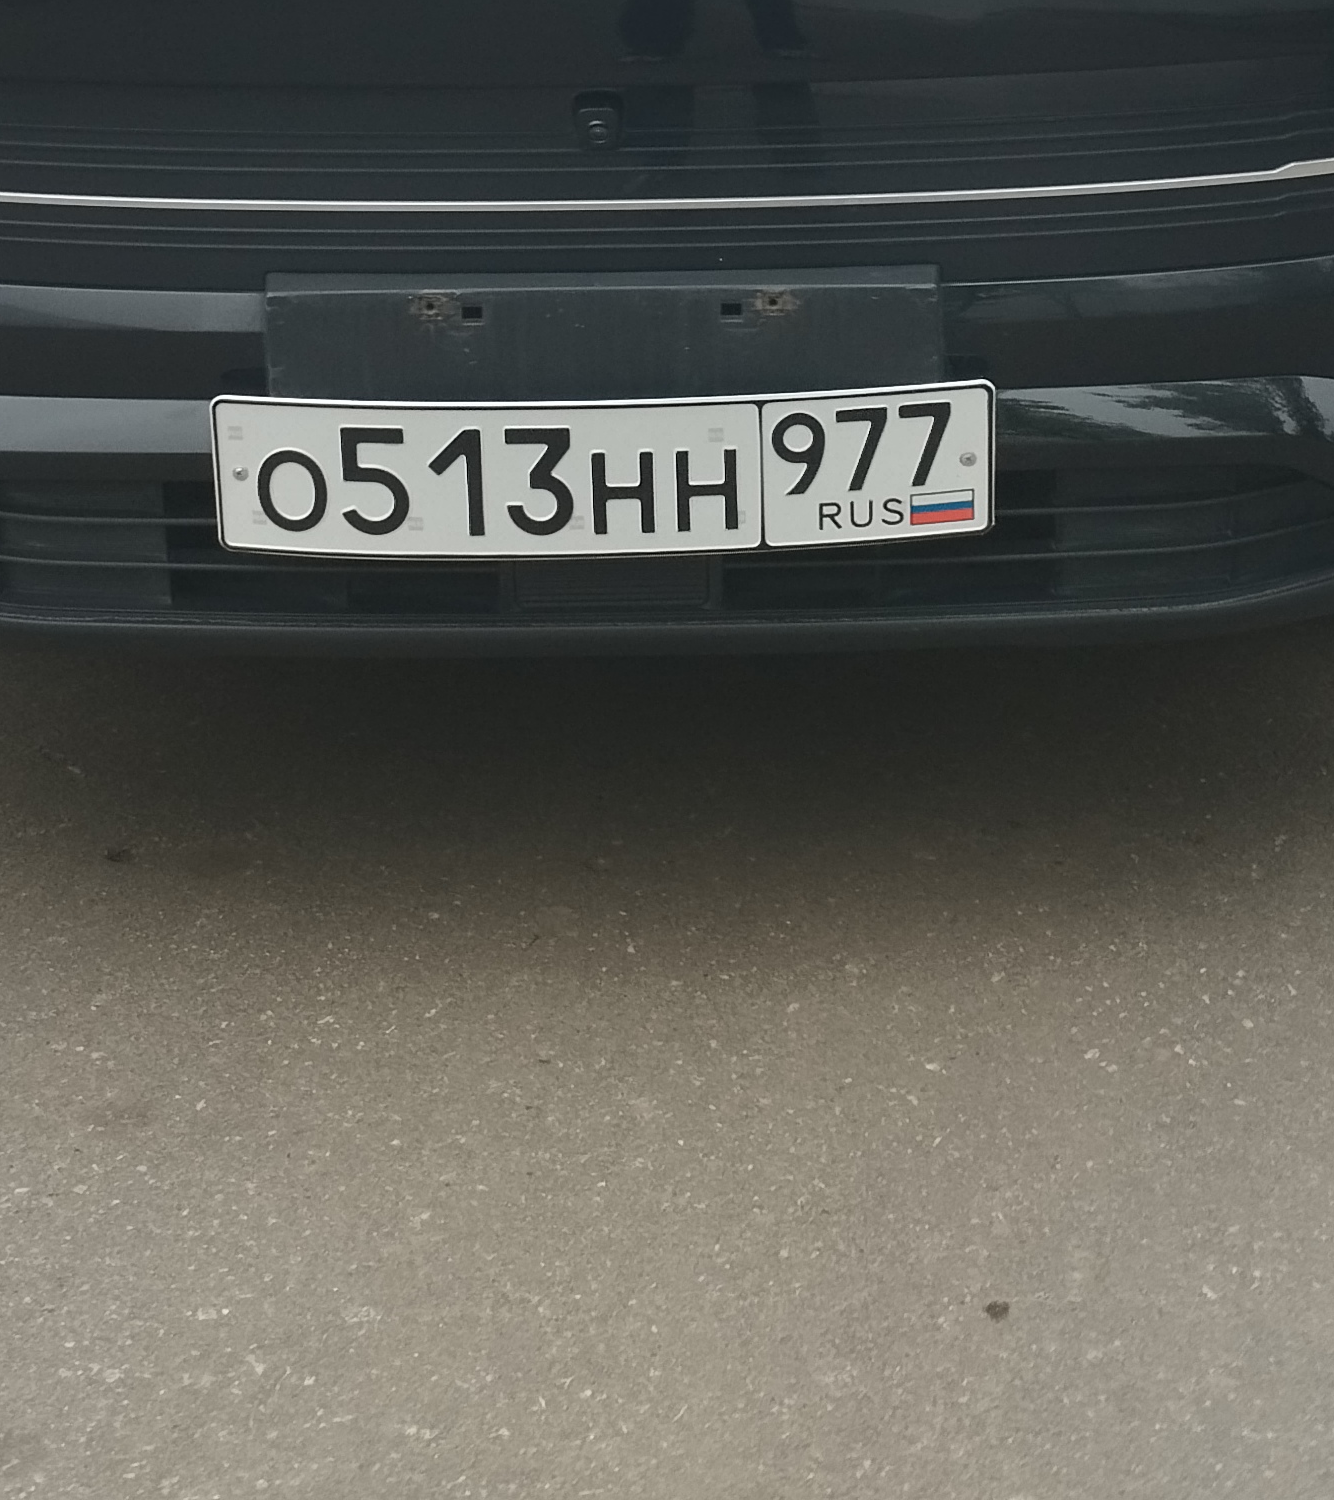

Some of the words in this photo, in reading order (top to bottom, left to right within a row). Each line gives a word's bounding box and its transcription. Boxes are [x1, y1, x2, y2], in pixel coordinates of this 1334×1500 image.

[257, 427, 739, 537] О513НН
[771, 401, 952, 496] 977
[818, 497, 904, 531] RUS
